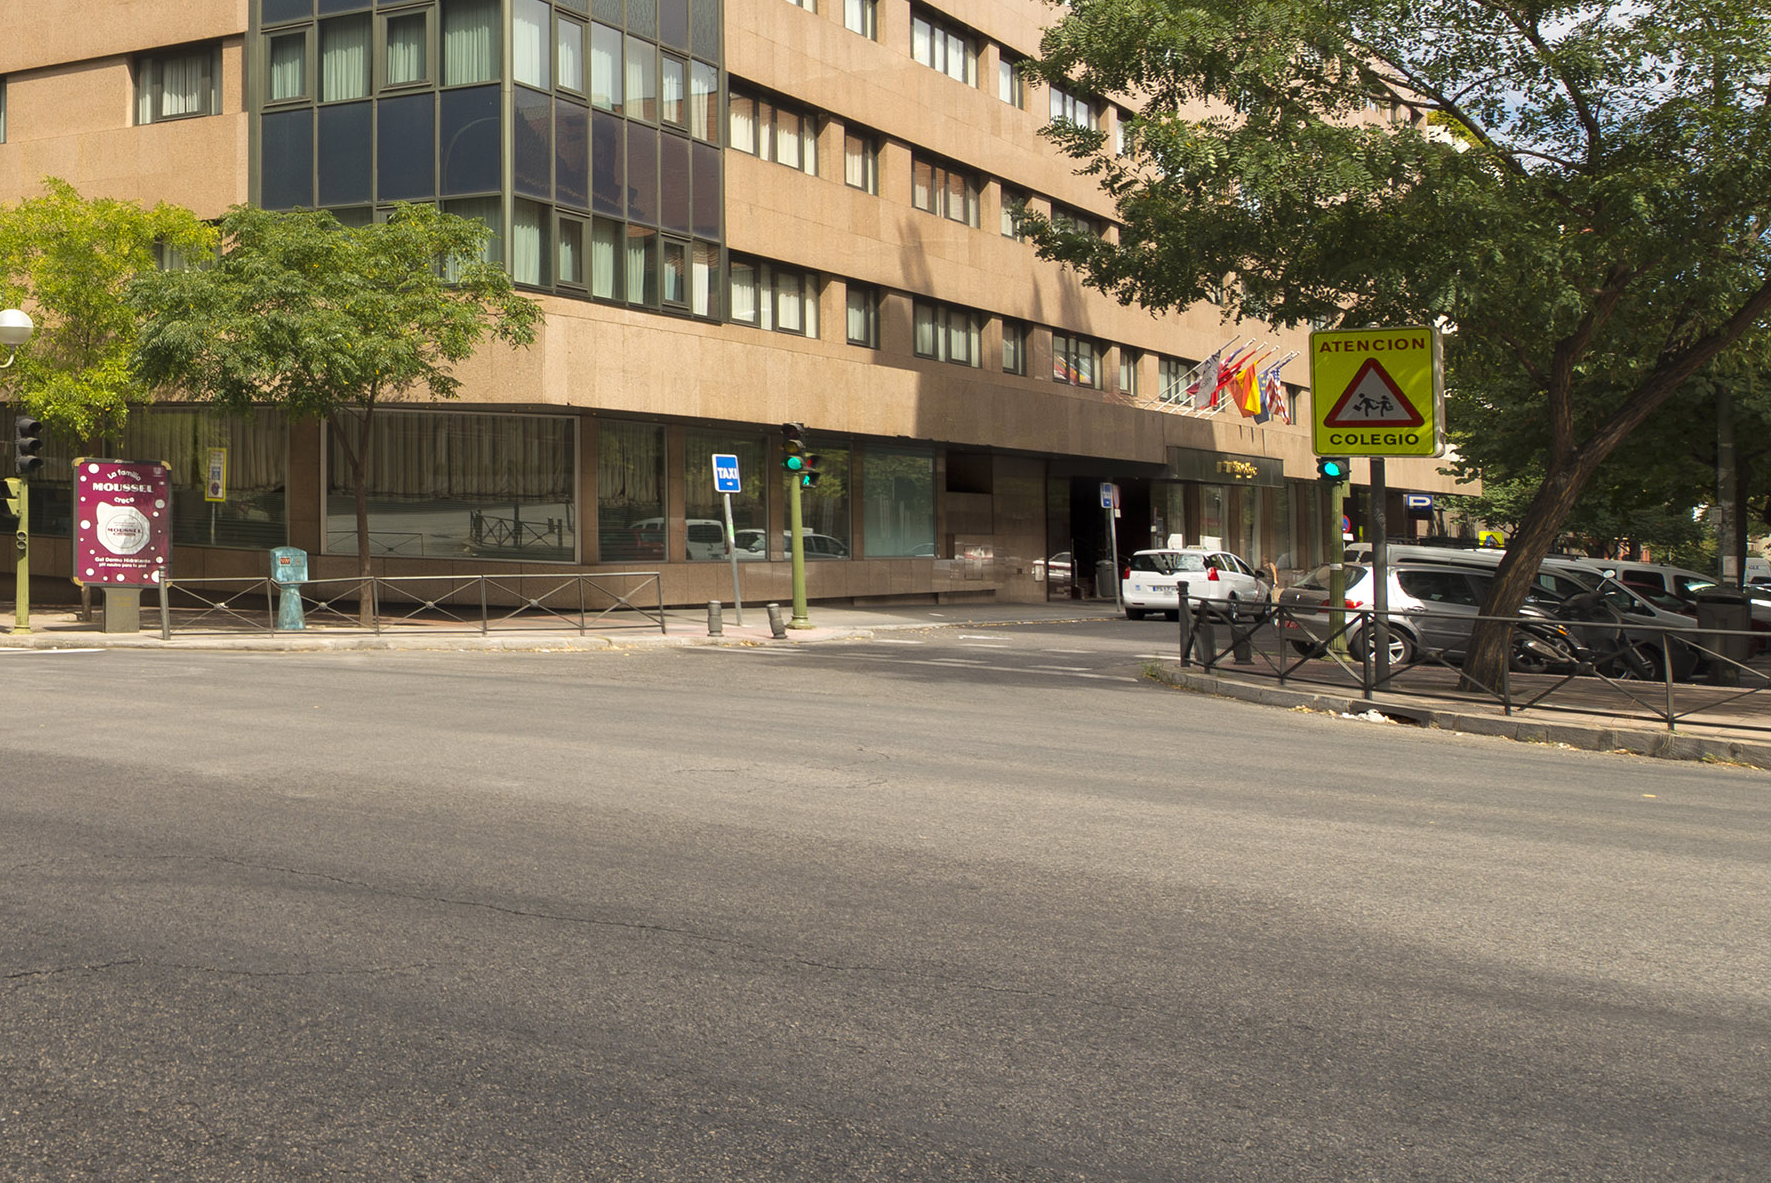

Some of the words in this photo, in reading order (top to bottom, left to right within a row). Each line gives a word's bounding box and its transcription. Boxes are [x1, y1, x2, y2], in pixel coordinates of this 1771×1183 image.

[1319, 338, 1425, 353] ATENCION
[1330, 433, 1419, 446] COLEGIO
[107, 471, 117, 480] La
[117, 469, 141, 481] familia
[717, 467, 738, 479] TAXI
[92, 482, 154, 493] MOUSSEL
[1409, 496, 1431, 506] P
